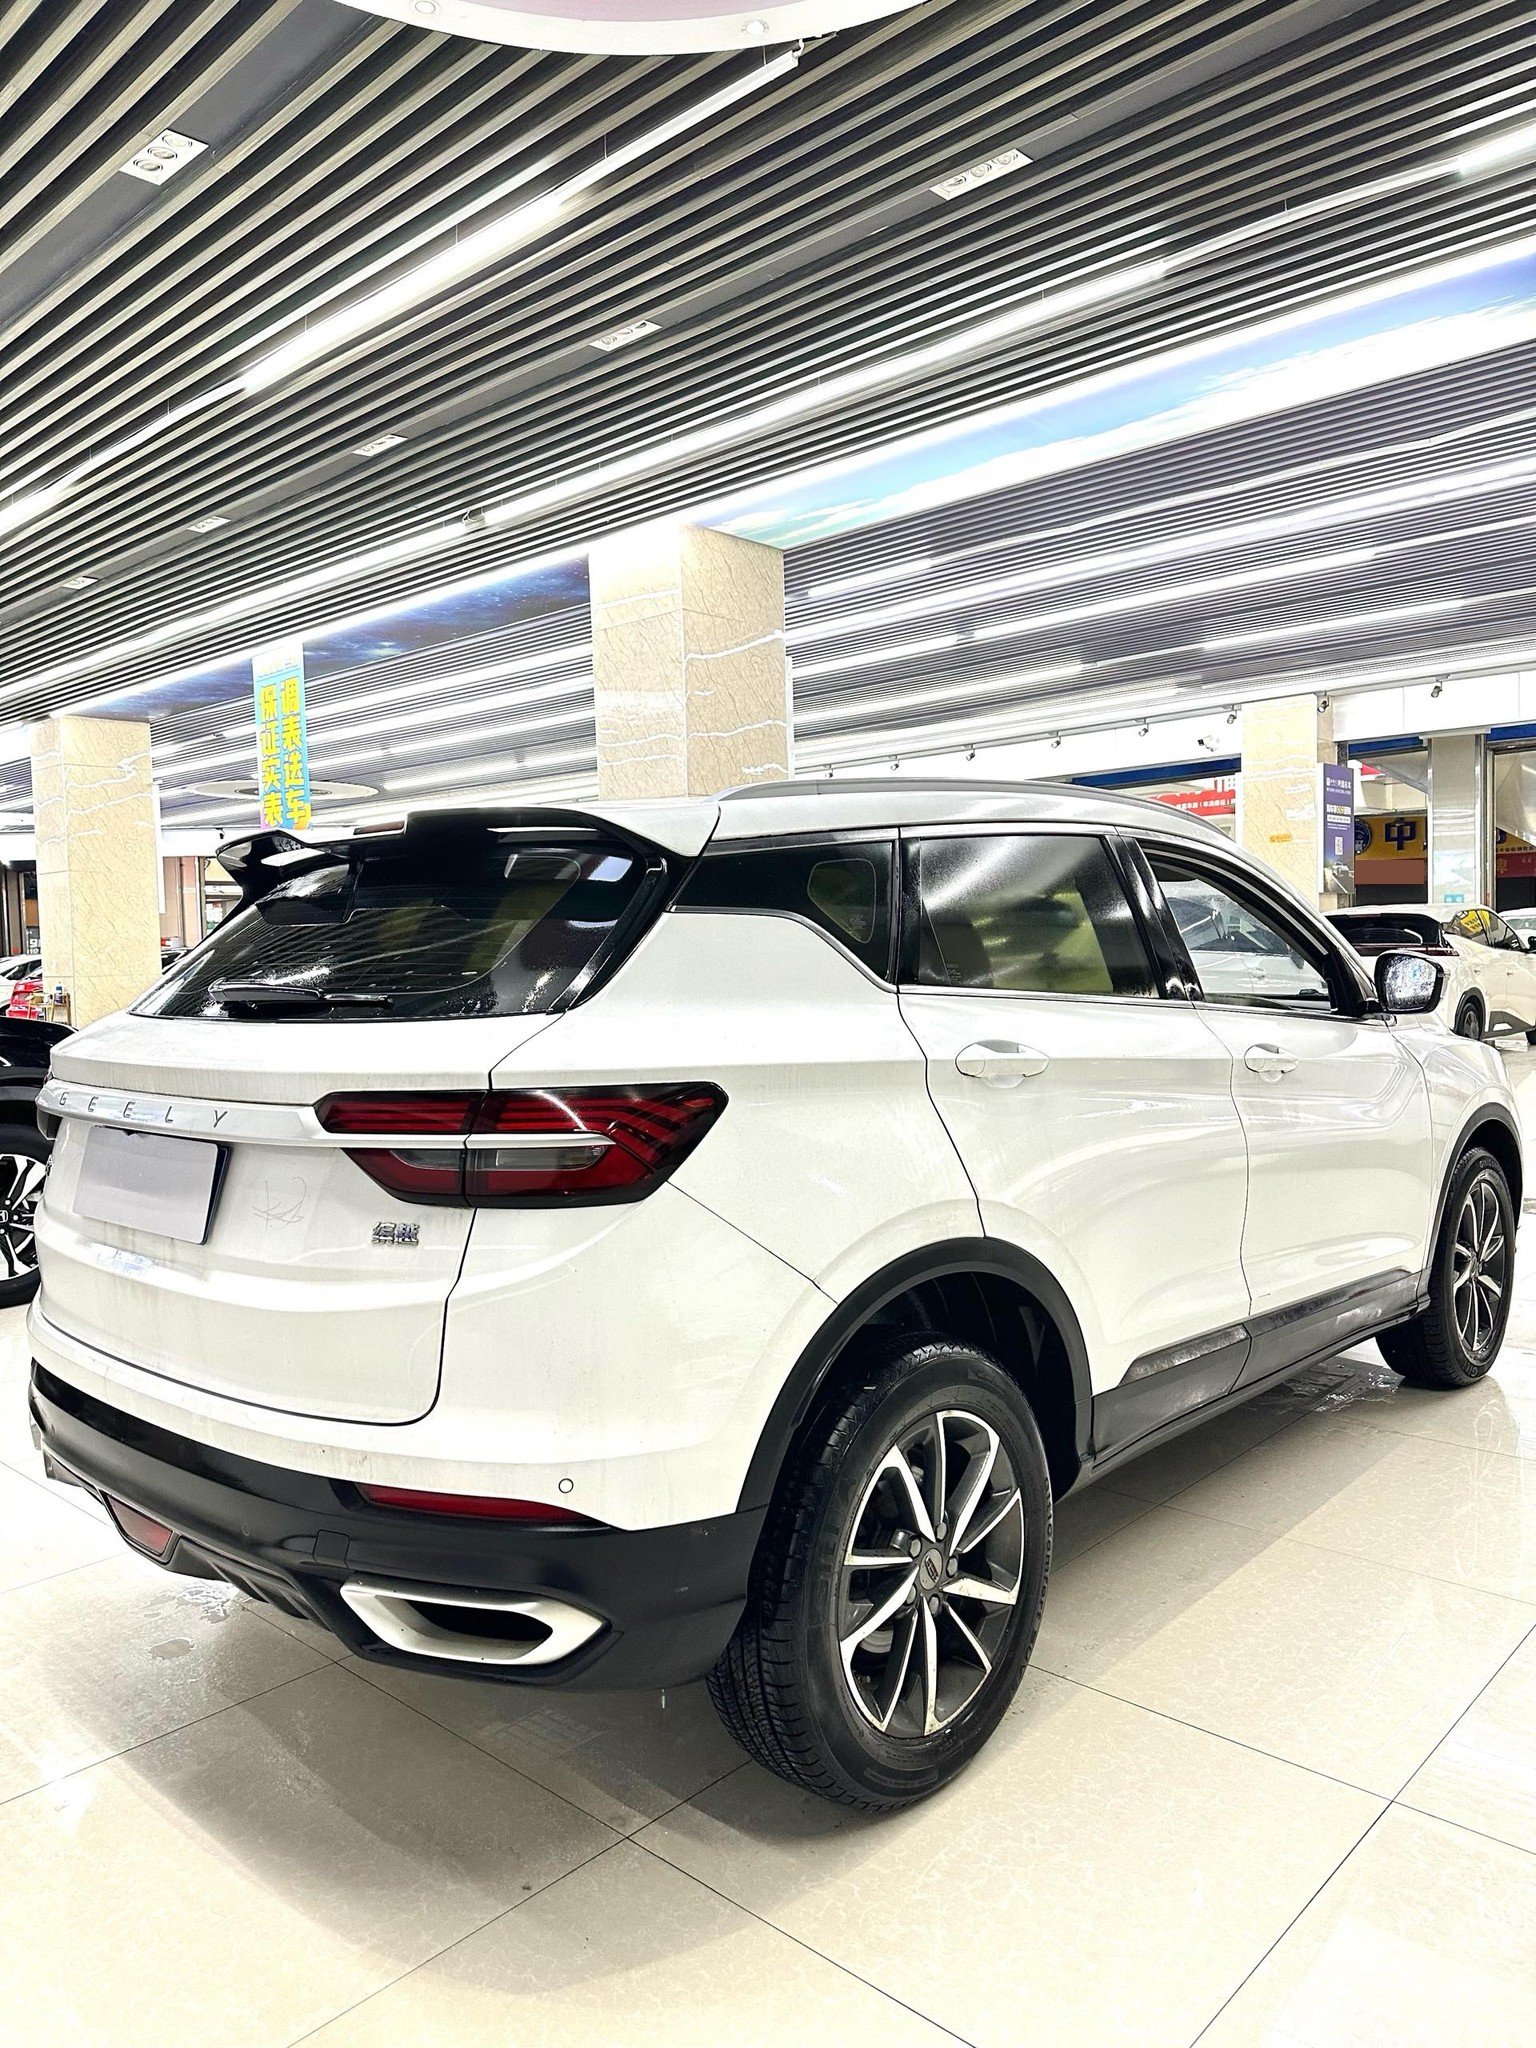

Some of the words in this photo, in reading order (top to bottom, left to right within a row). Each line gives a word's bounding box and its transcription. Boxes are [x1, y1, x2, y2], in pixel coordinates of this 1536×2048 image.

[260, 684, 283, 828] 保证实表
[280, 676, 308, 825] 调表送车
[59, 1091, 229, 1128] GEELY
[371, 1220, 420, 1246] 缤越
